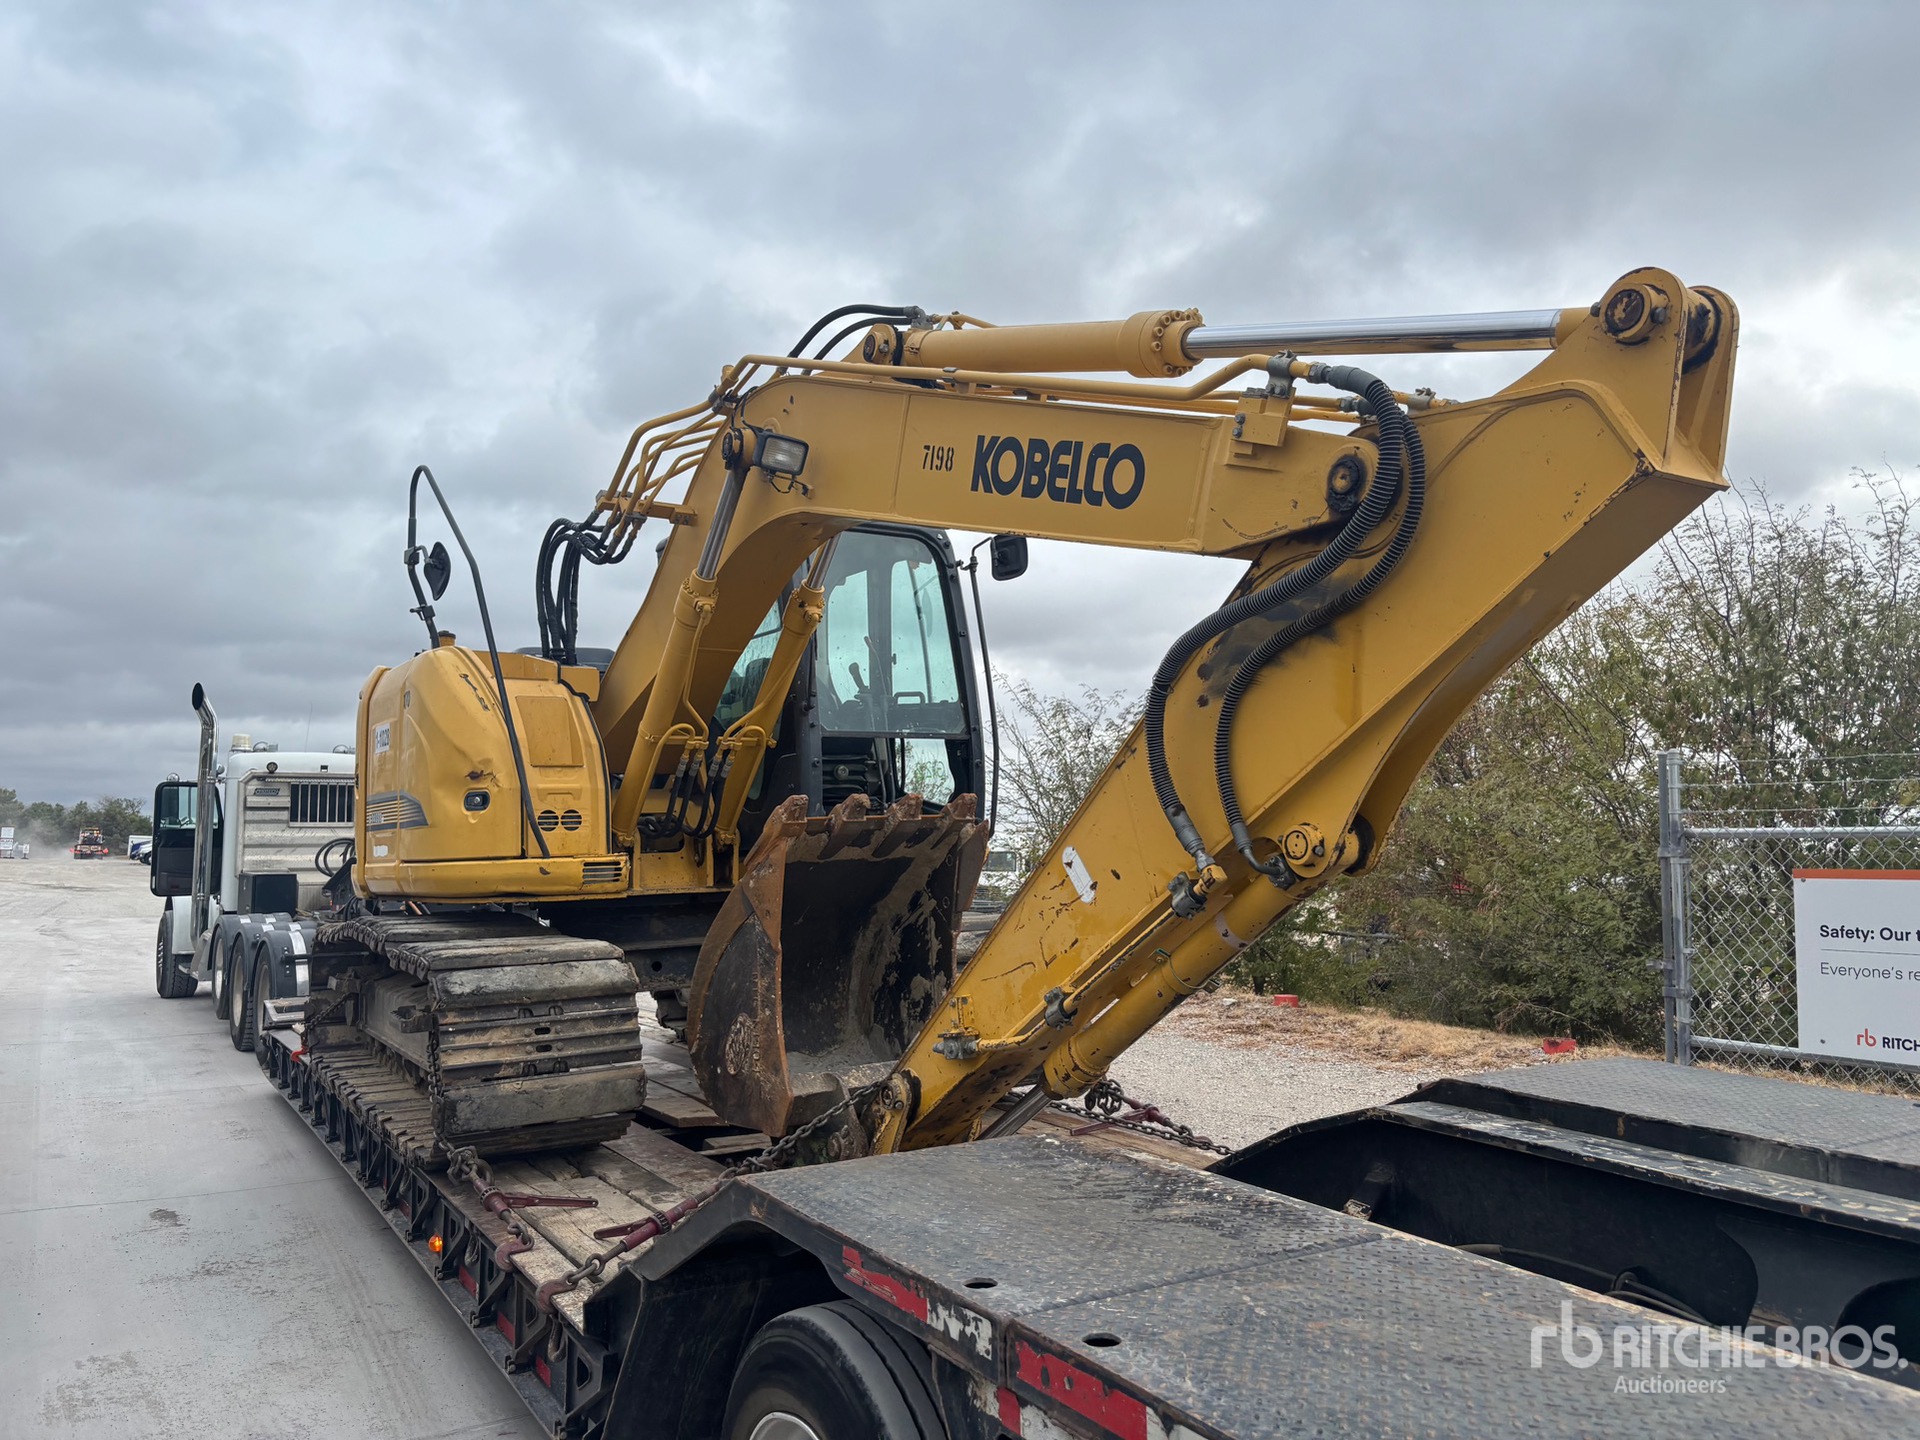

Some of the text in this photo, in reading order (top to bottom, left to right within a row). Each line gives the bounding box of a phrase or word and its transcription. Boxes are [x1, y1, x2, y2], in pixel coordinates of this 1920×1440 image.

[922, 434, 1146, 510] 7198 KOBELCO
[1820, 924, 1875, 943] Safety:
[1879, 927, 1912, 941] Our
[1820, 962, 1903, 980] Everyone's
[1856, 1028, 1877, 1047] rb
